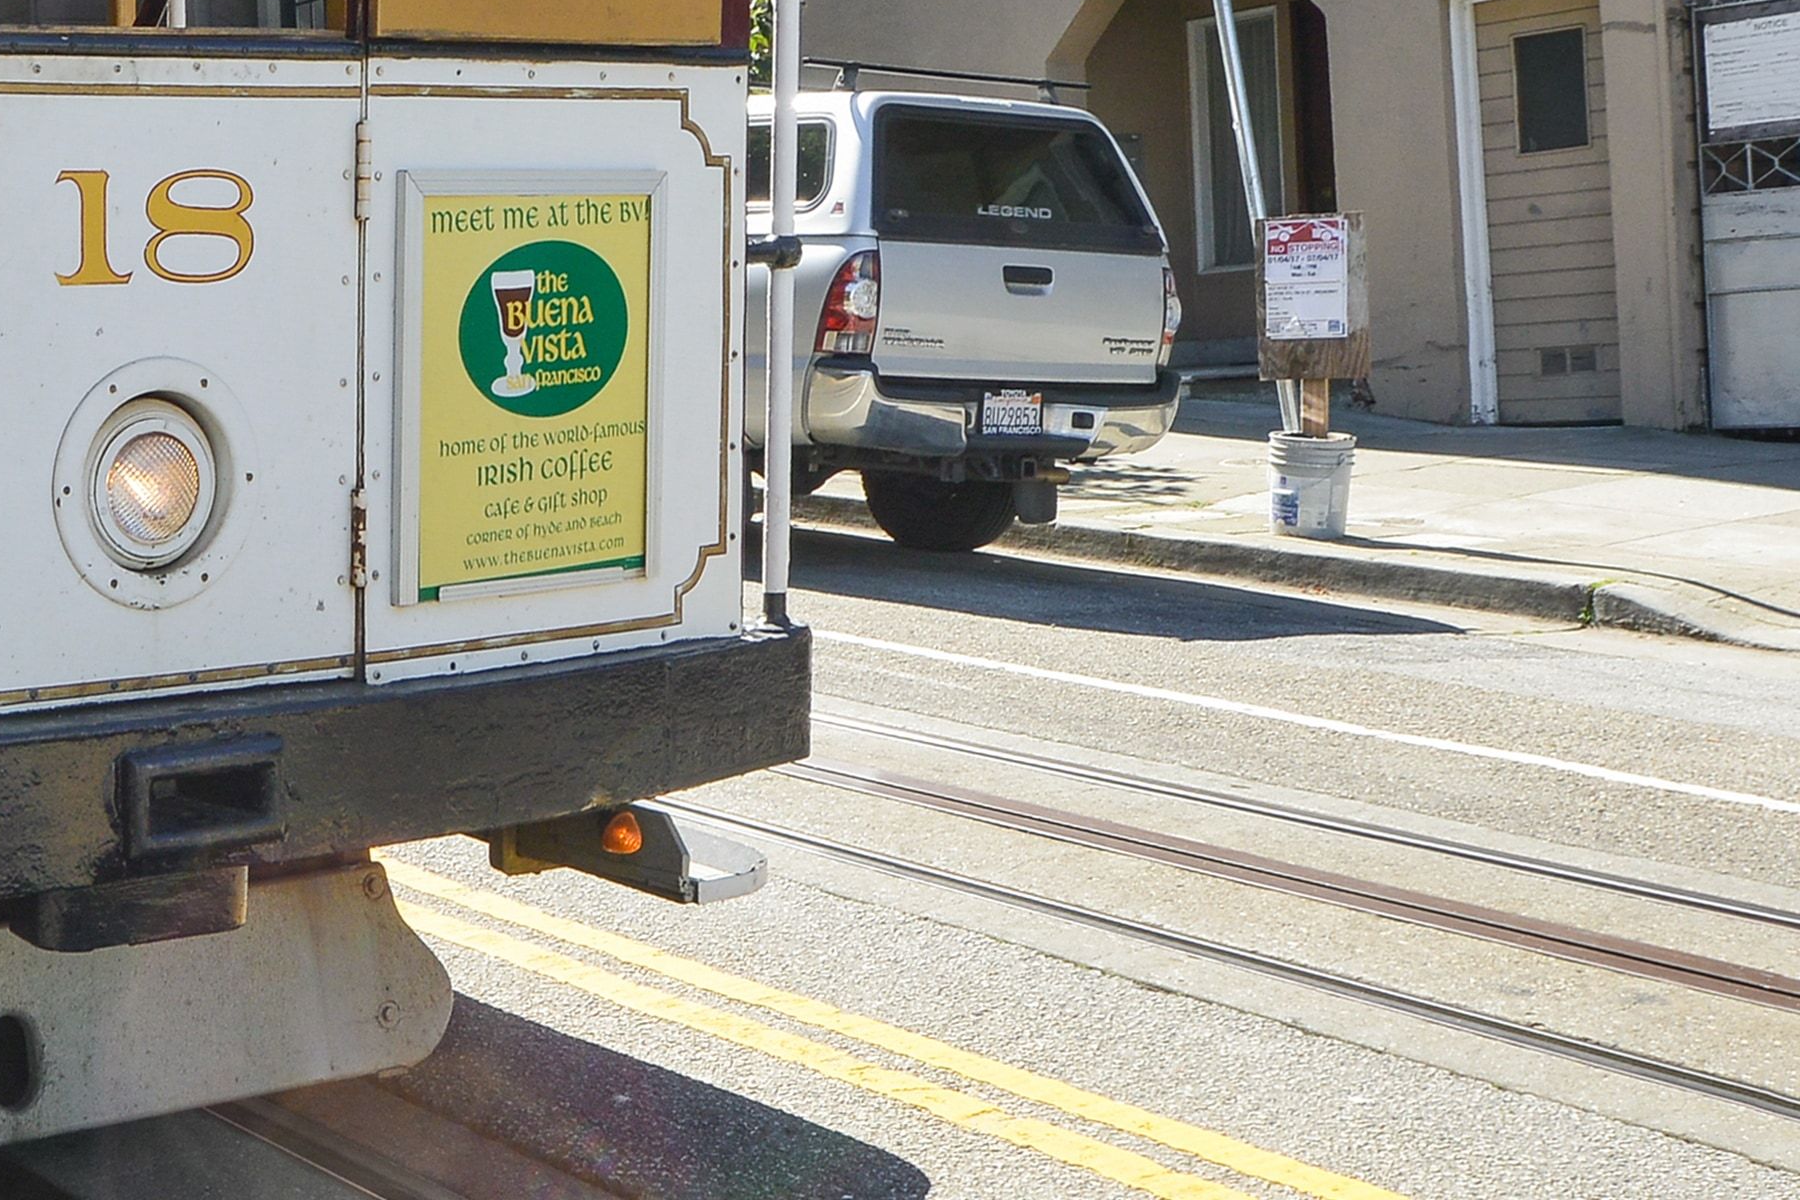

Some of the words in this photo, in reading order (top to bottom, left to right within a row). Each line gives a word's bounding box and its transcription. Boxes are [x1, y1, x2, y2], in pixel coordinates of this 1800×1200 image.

[1753, 19, 1788, 31] NOTICE
[431, 205, 495, 234] meet
[503, 205, 540, 229] me
[547, 202, 569, 227] at
[574, 198, 612, 226] the
[977, 204, 1052, 219] LEGEND
[54, 169, 254, 285] 18
[1288, 242, 1338, 253] STOPPING
[536, 270, 569, 294] the
[439, 438, 485, 457] home
[490, 433, 508, 454] of
[512, 431, 539, 450] the
[571, 487, 608, 507] shop
